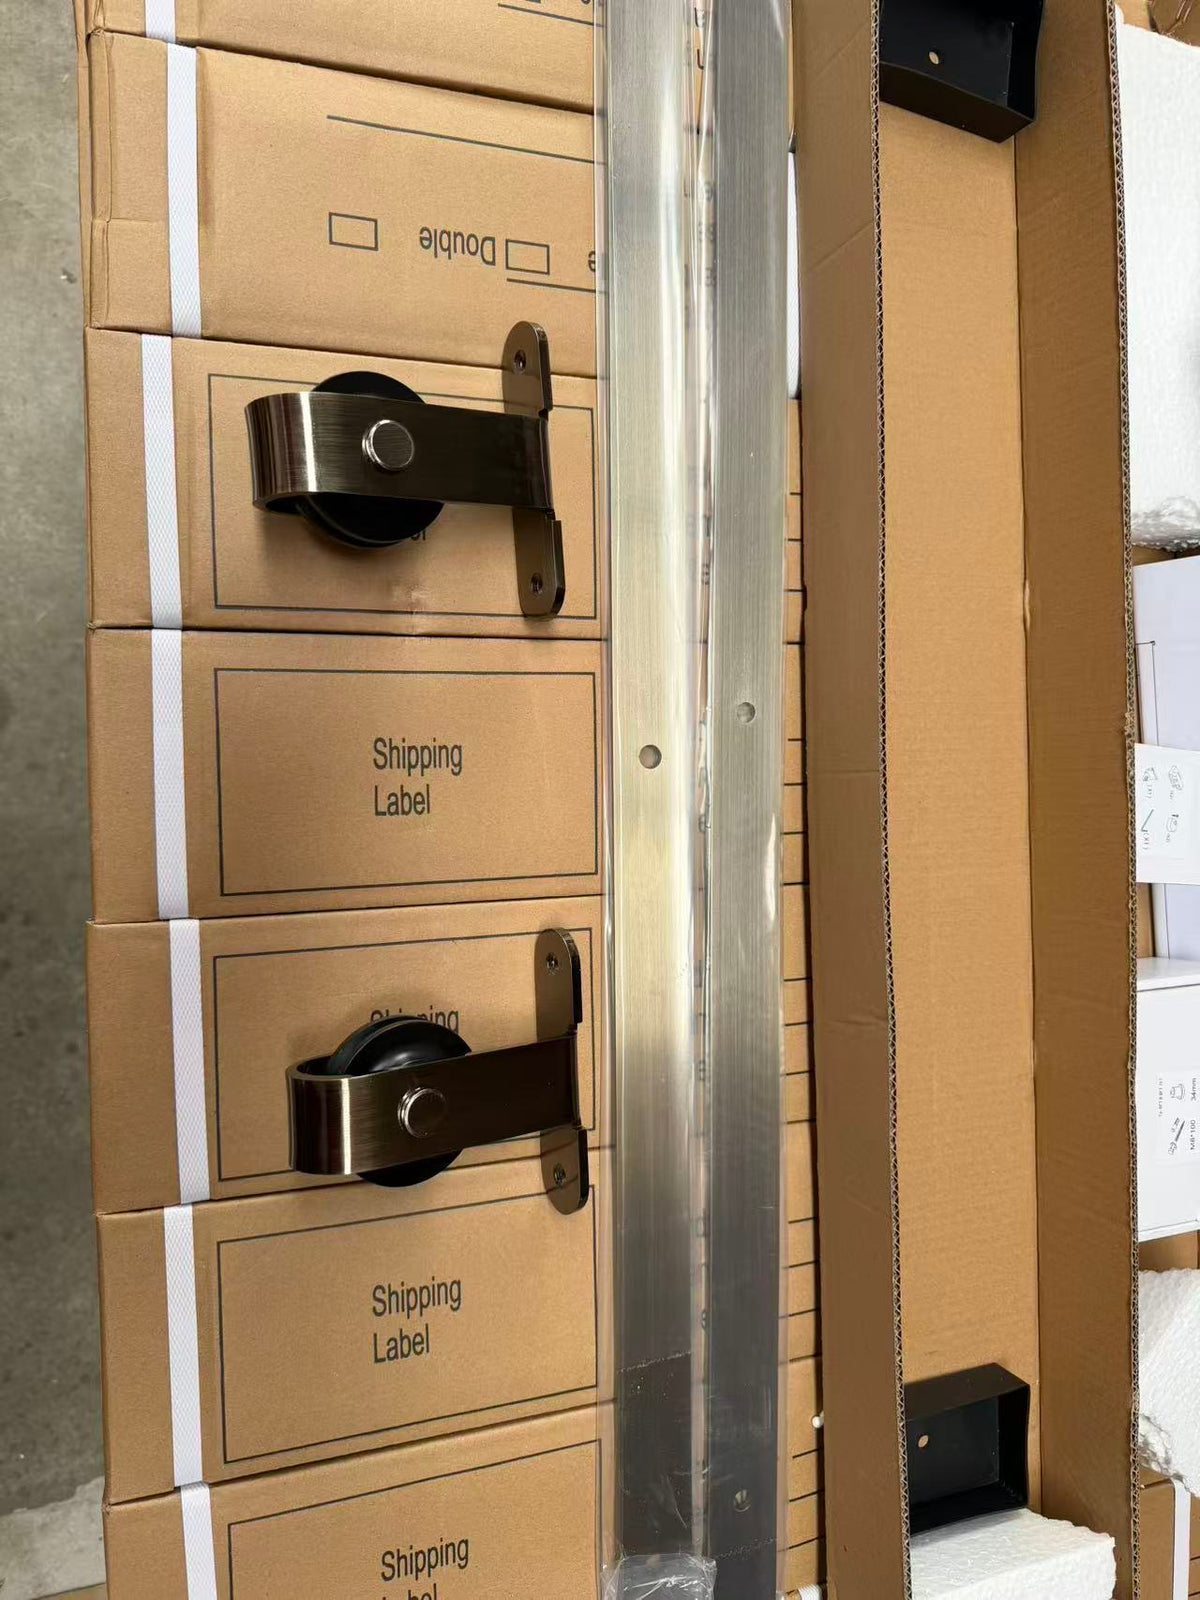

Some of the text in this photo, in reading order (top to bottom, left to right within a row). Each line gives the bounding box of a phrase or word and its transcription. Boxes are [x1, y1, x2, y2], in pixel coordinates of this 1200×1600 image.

[419, 226, 496, 266] Double
[373, 737, 462, 776] Shipping
[374, 784, 430, 816] Label
[372, 1275, 462, 1319] Shipping
[373, 1323, 430, 1363] Label
[381, 1537, 469, 1581] Shipping
